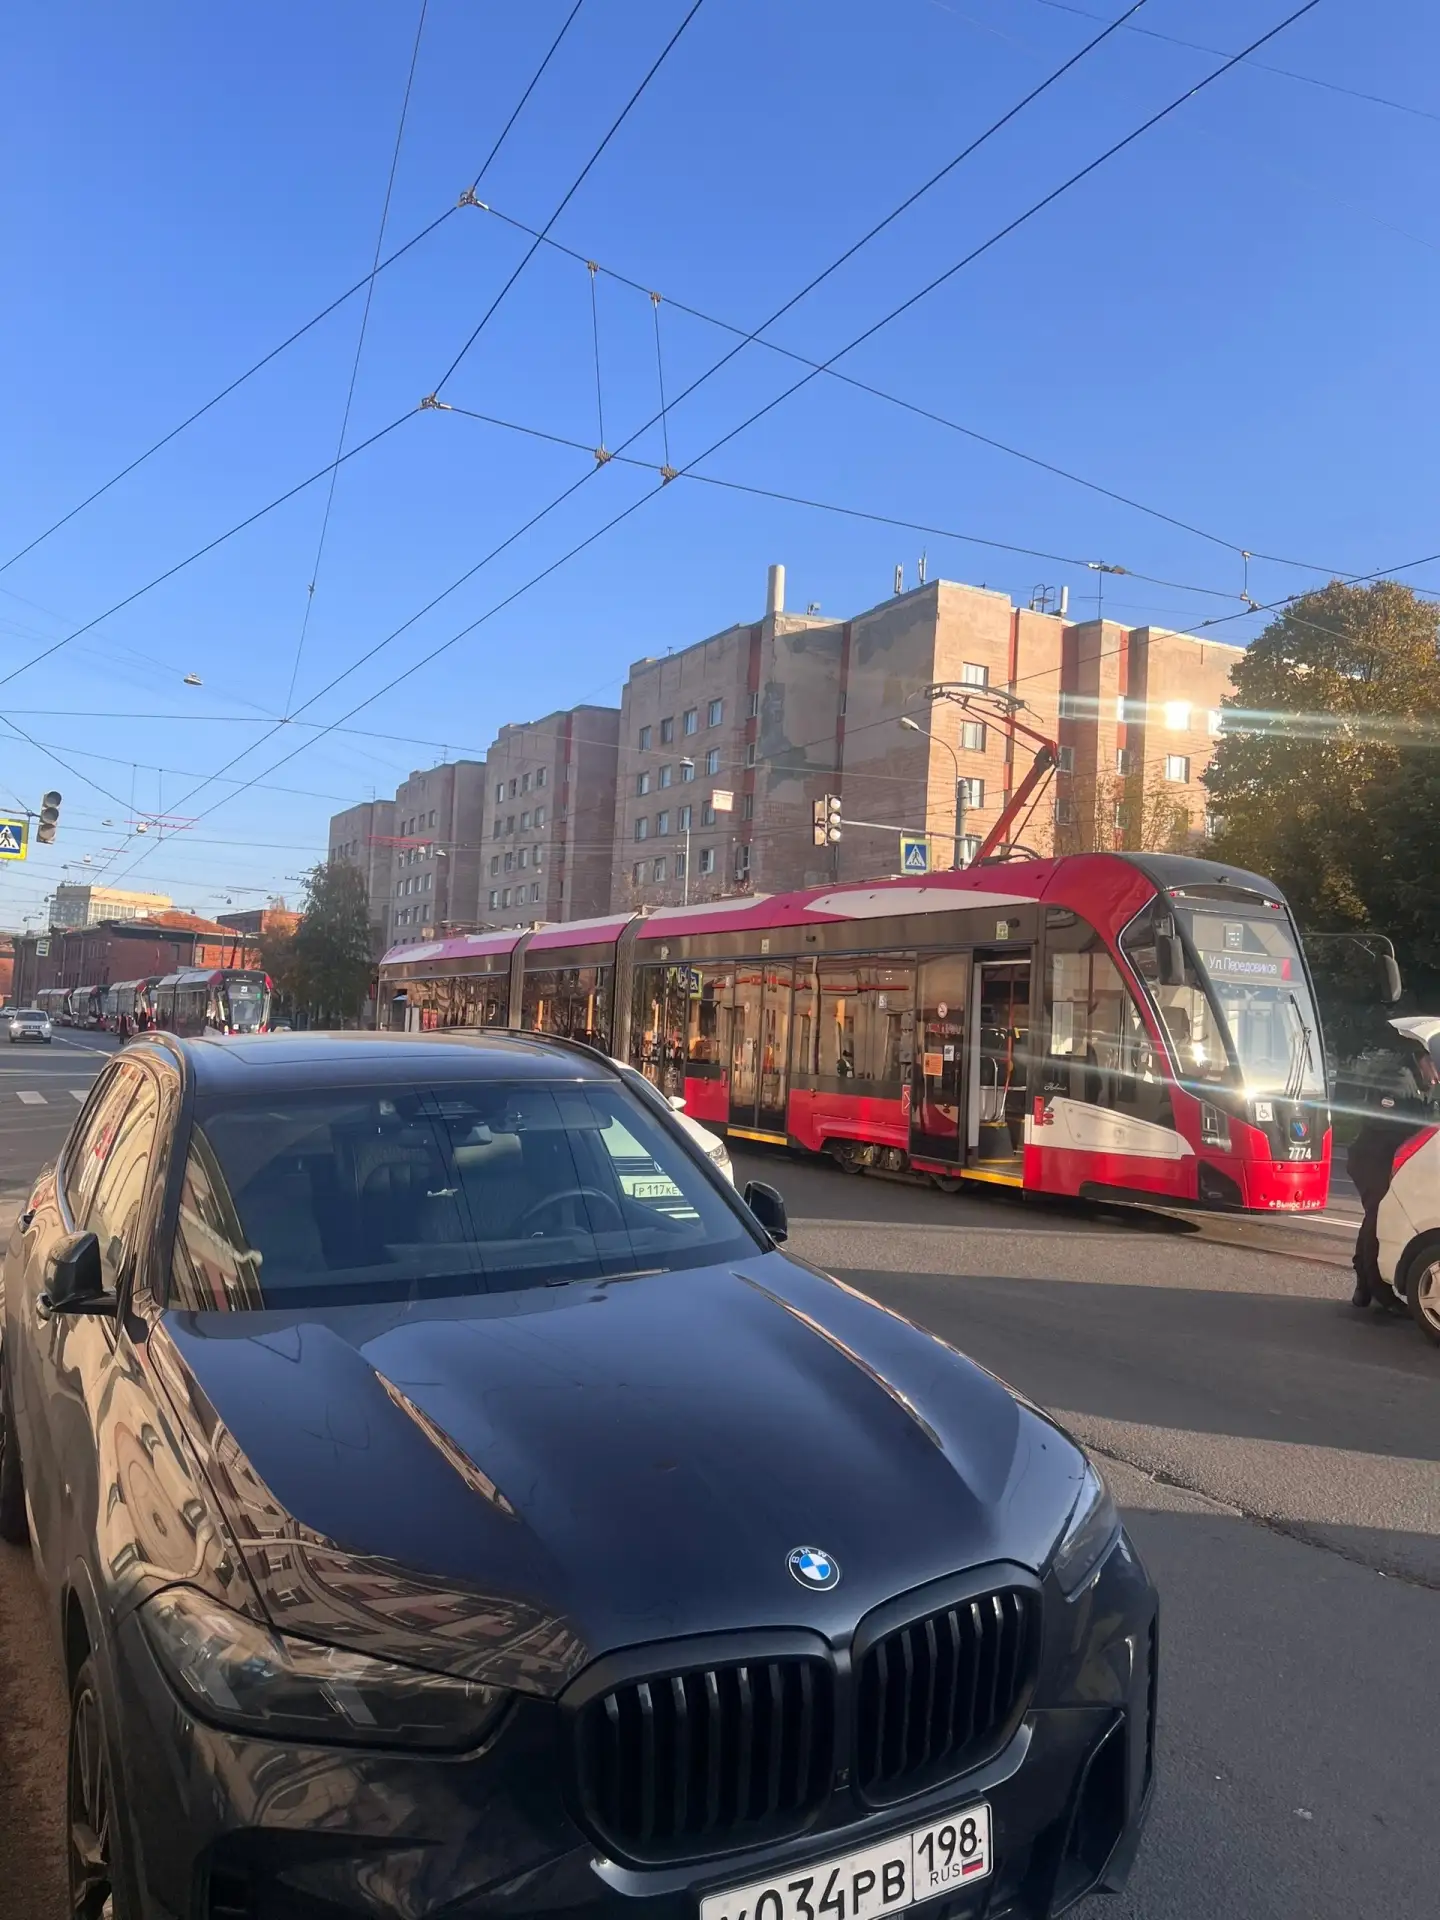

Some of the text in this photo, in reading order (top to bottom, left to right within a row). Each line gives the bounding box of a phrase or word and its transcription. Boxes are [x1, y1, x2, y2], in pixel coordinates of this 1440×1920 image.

[1288, 1147, 1312, 1160] 7774
[791, 1548, 827, 1564] BMW
[720, 1817, 977, 1920] 034РВ 198
[930, 1865, 960, 1887] RUS
